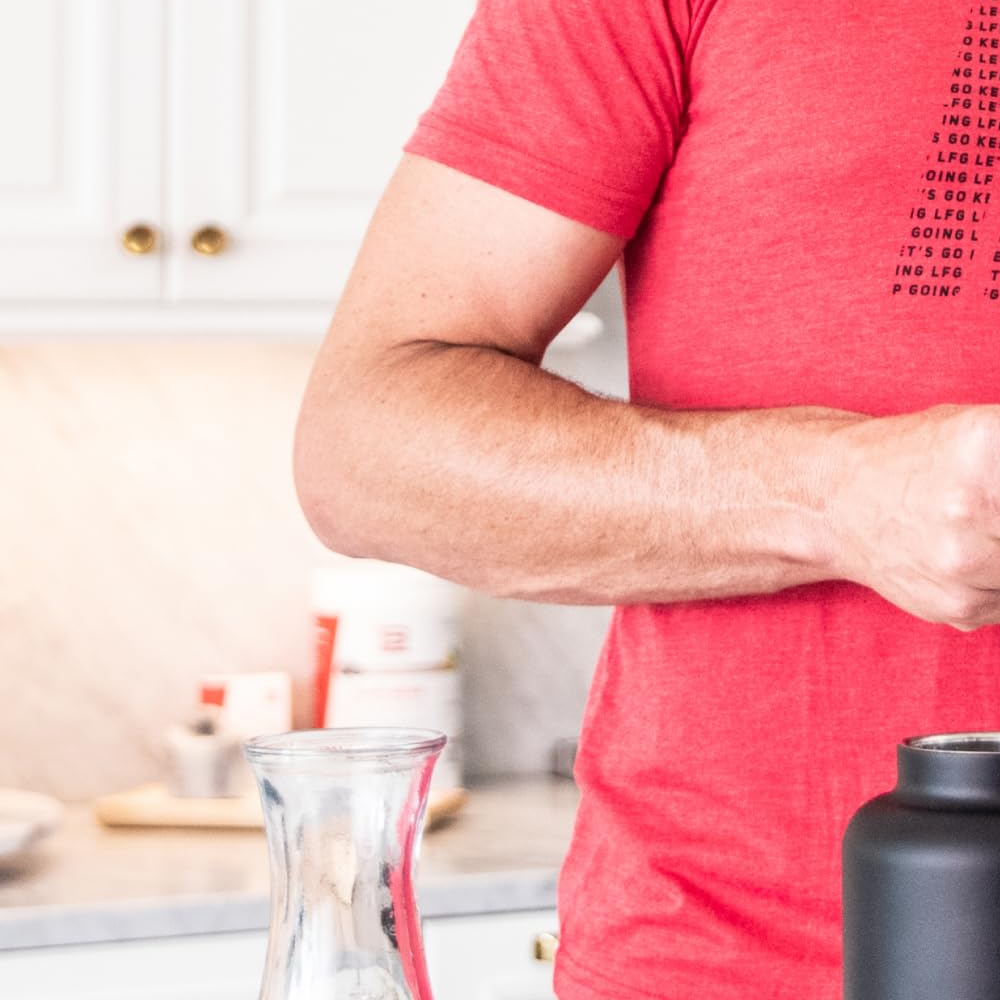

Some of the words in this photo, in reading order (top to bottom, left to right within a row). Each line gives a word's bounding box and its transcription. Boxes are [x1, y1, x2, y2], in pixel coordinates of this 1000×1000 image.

[949, 83, 973, 95] GO
[947, 132, 971, 146] GO
[937, 151, 969, 165] LFG
[943, 189, 967, 203] GO
[933, 208, 965, 222] LFG
[911, 226, 965, 241] GOING
[941, 247, 963, 260] GO
[931, 266, 962, 279] LFG
